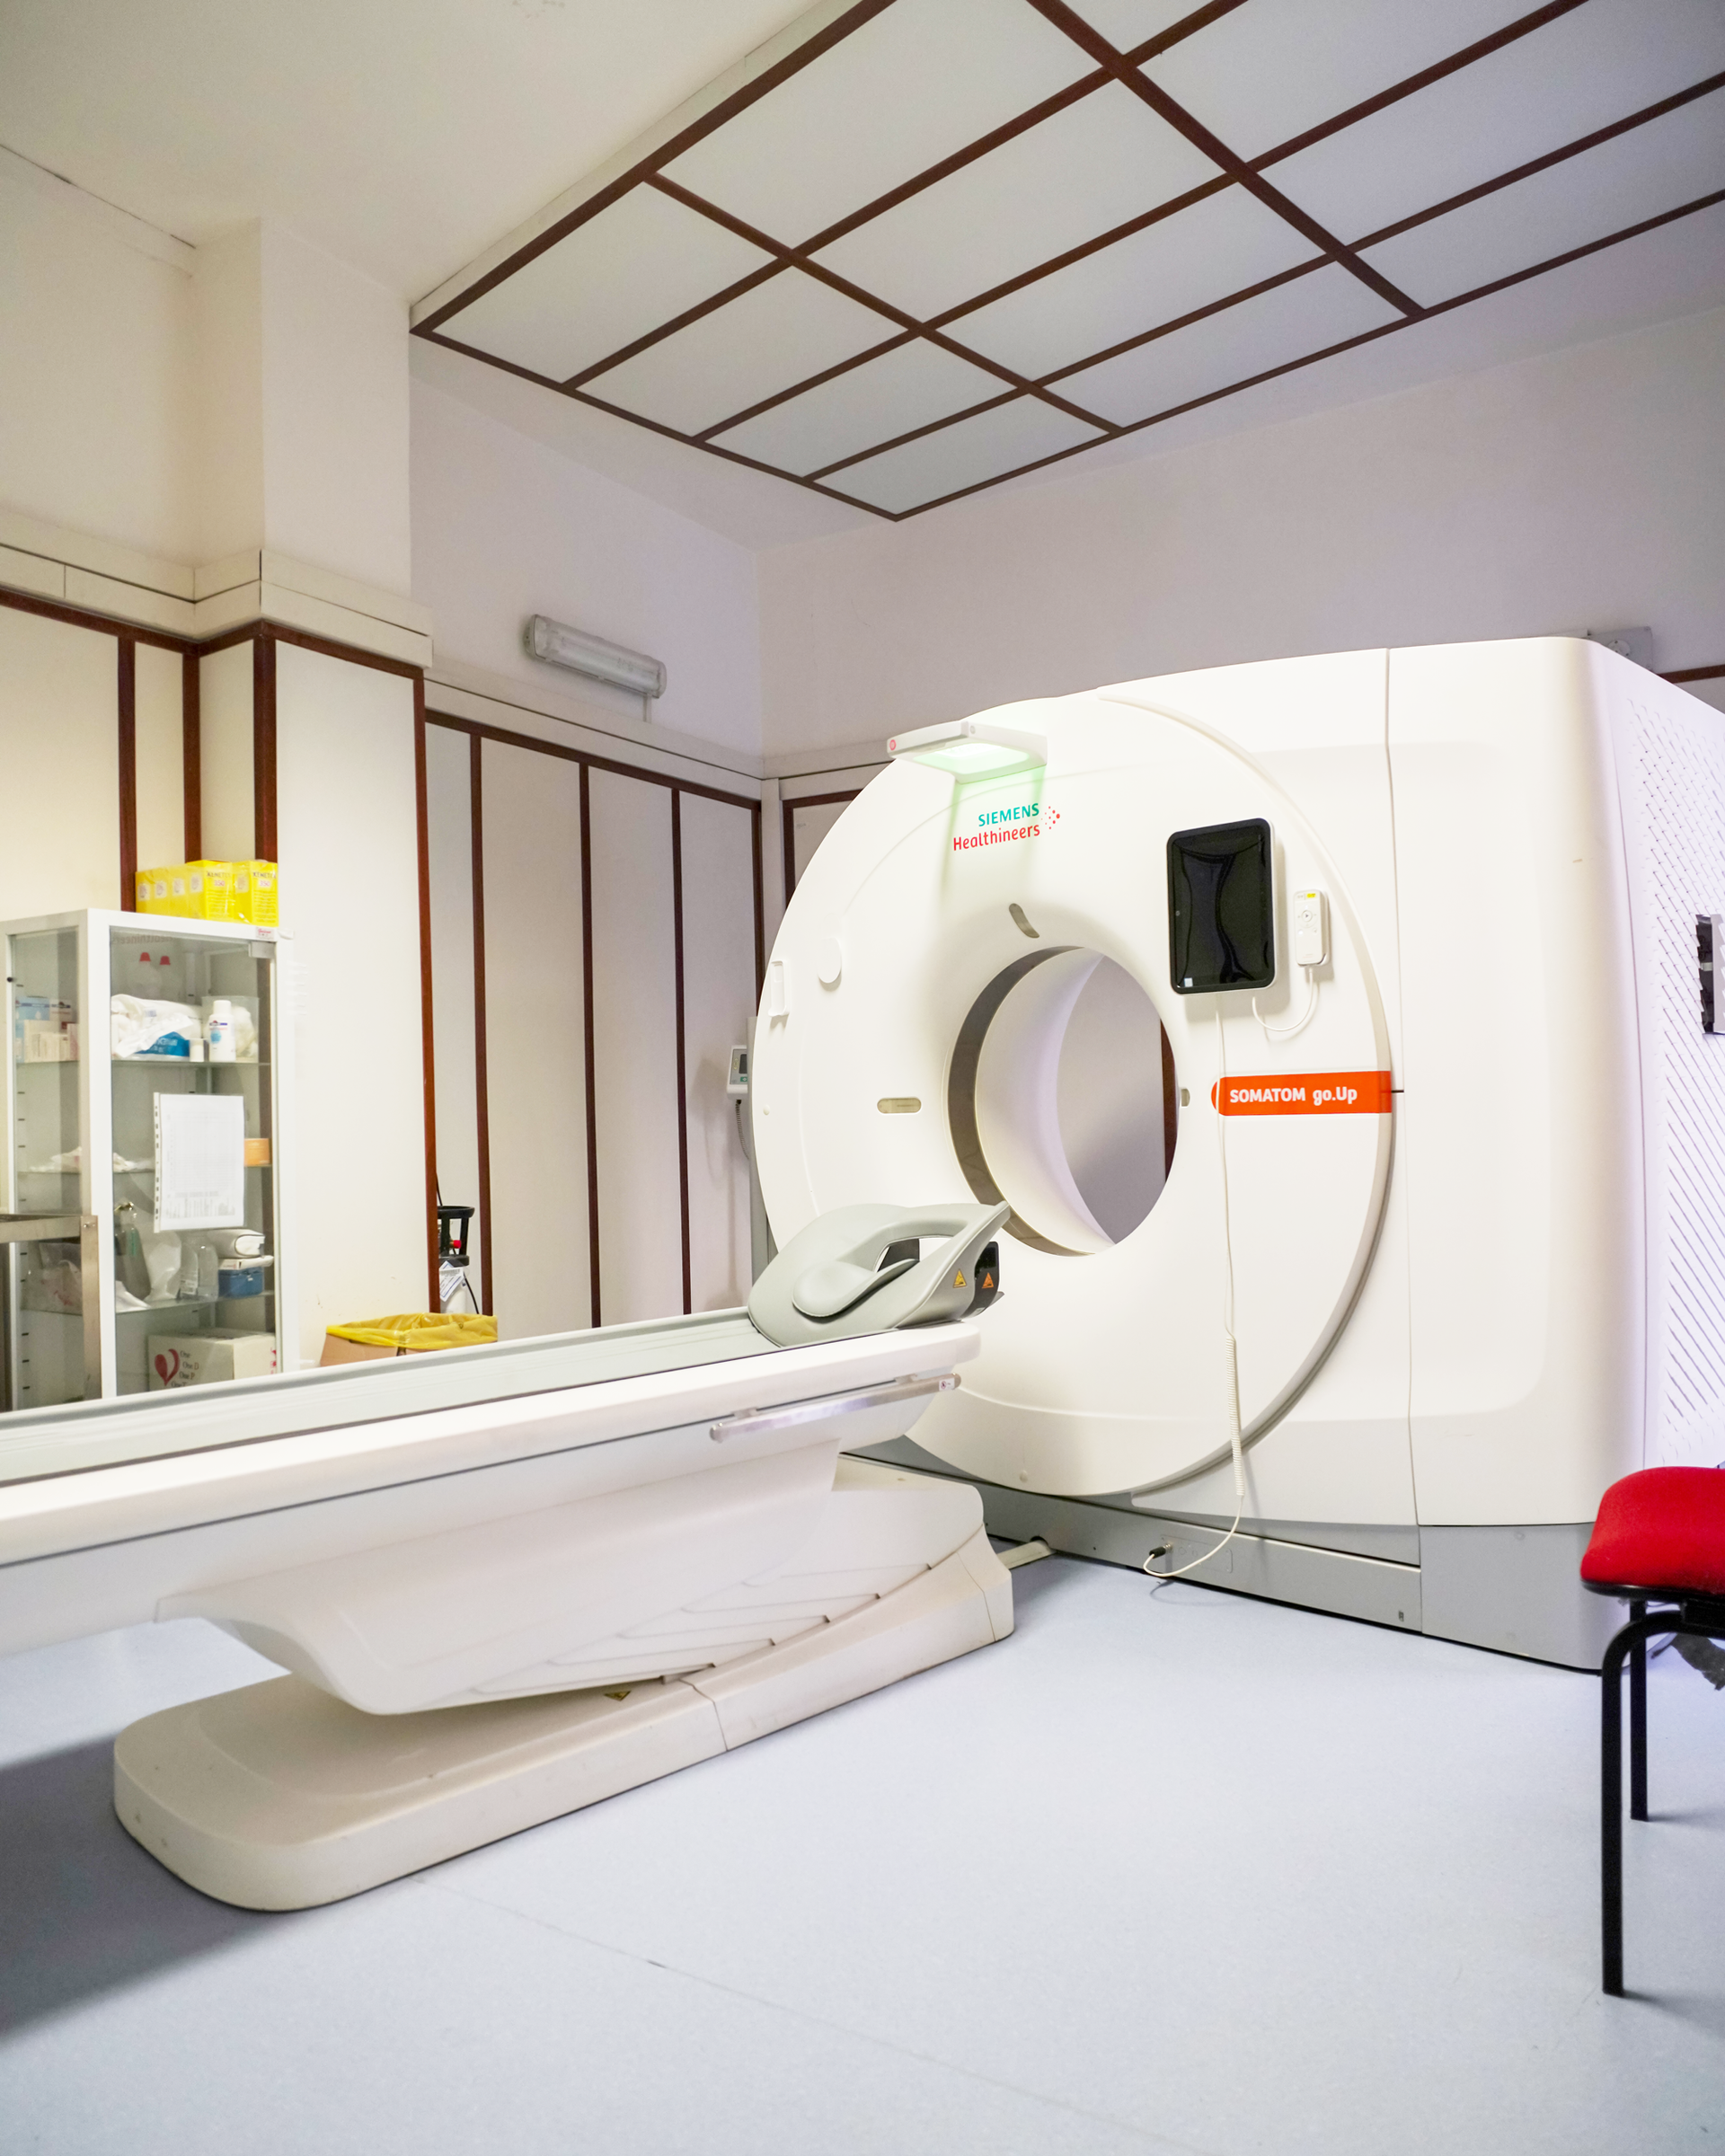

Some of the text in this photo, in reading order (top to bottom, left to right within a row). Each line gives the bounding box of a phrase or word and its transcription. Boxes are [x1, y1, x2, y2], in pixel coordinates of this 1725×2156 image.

[978, 803, 1039, 826] SIEMENS
[953, 825, 1040, 851] Healthineers
[1229, 1086, 1358, 1106] SOMATOM go.Up
